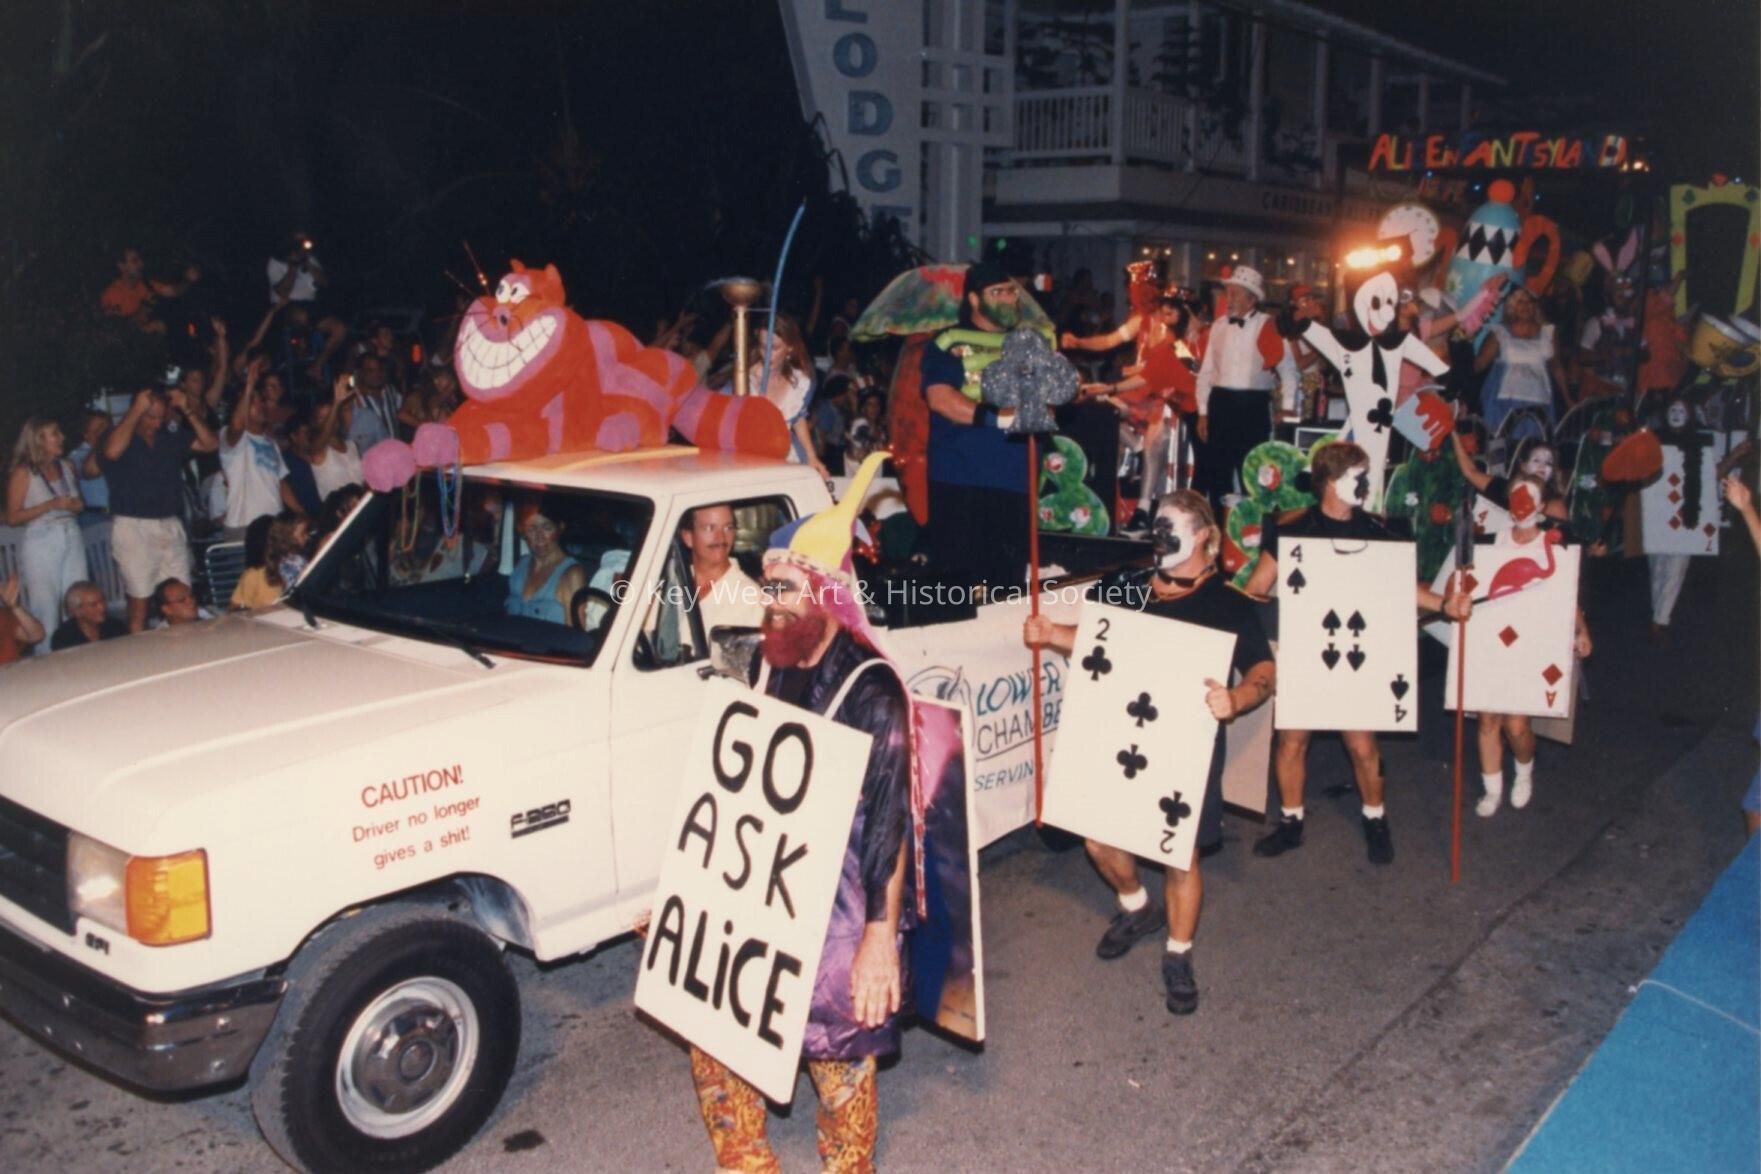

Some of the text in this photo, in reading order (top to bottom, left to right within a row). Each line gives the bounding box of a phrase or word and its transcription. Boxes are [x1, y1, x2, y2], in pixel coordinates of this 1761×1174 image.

[1289, 544, 1303, 563] 4
[1095, 617, 1111, 641] 2
[976, 661, 1061, 717] LOWR
[1545, 690, 1557, 709] A
[1394, 703, 1408, 723] 4
[712, 700, 814, 815] GO
[974, 760, 1034, 793] SERVIN
[361, 764, 464, 808] CAUTION!
[352, 796, 481, 843] Driver no longer
[374, 826, 471, 869] gives a shit!
[677, 792, 809, 919] ASK
[1159, 829, 1176, 854] 2
